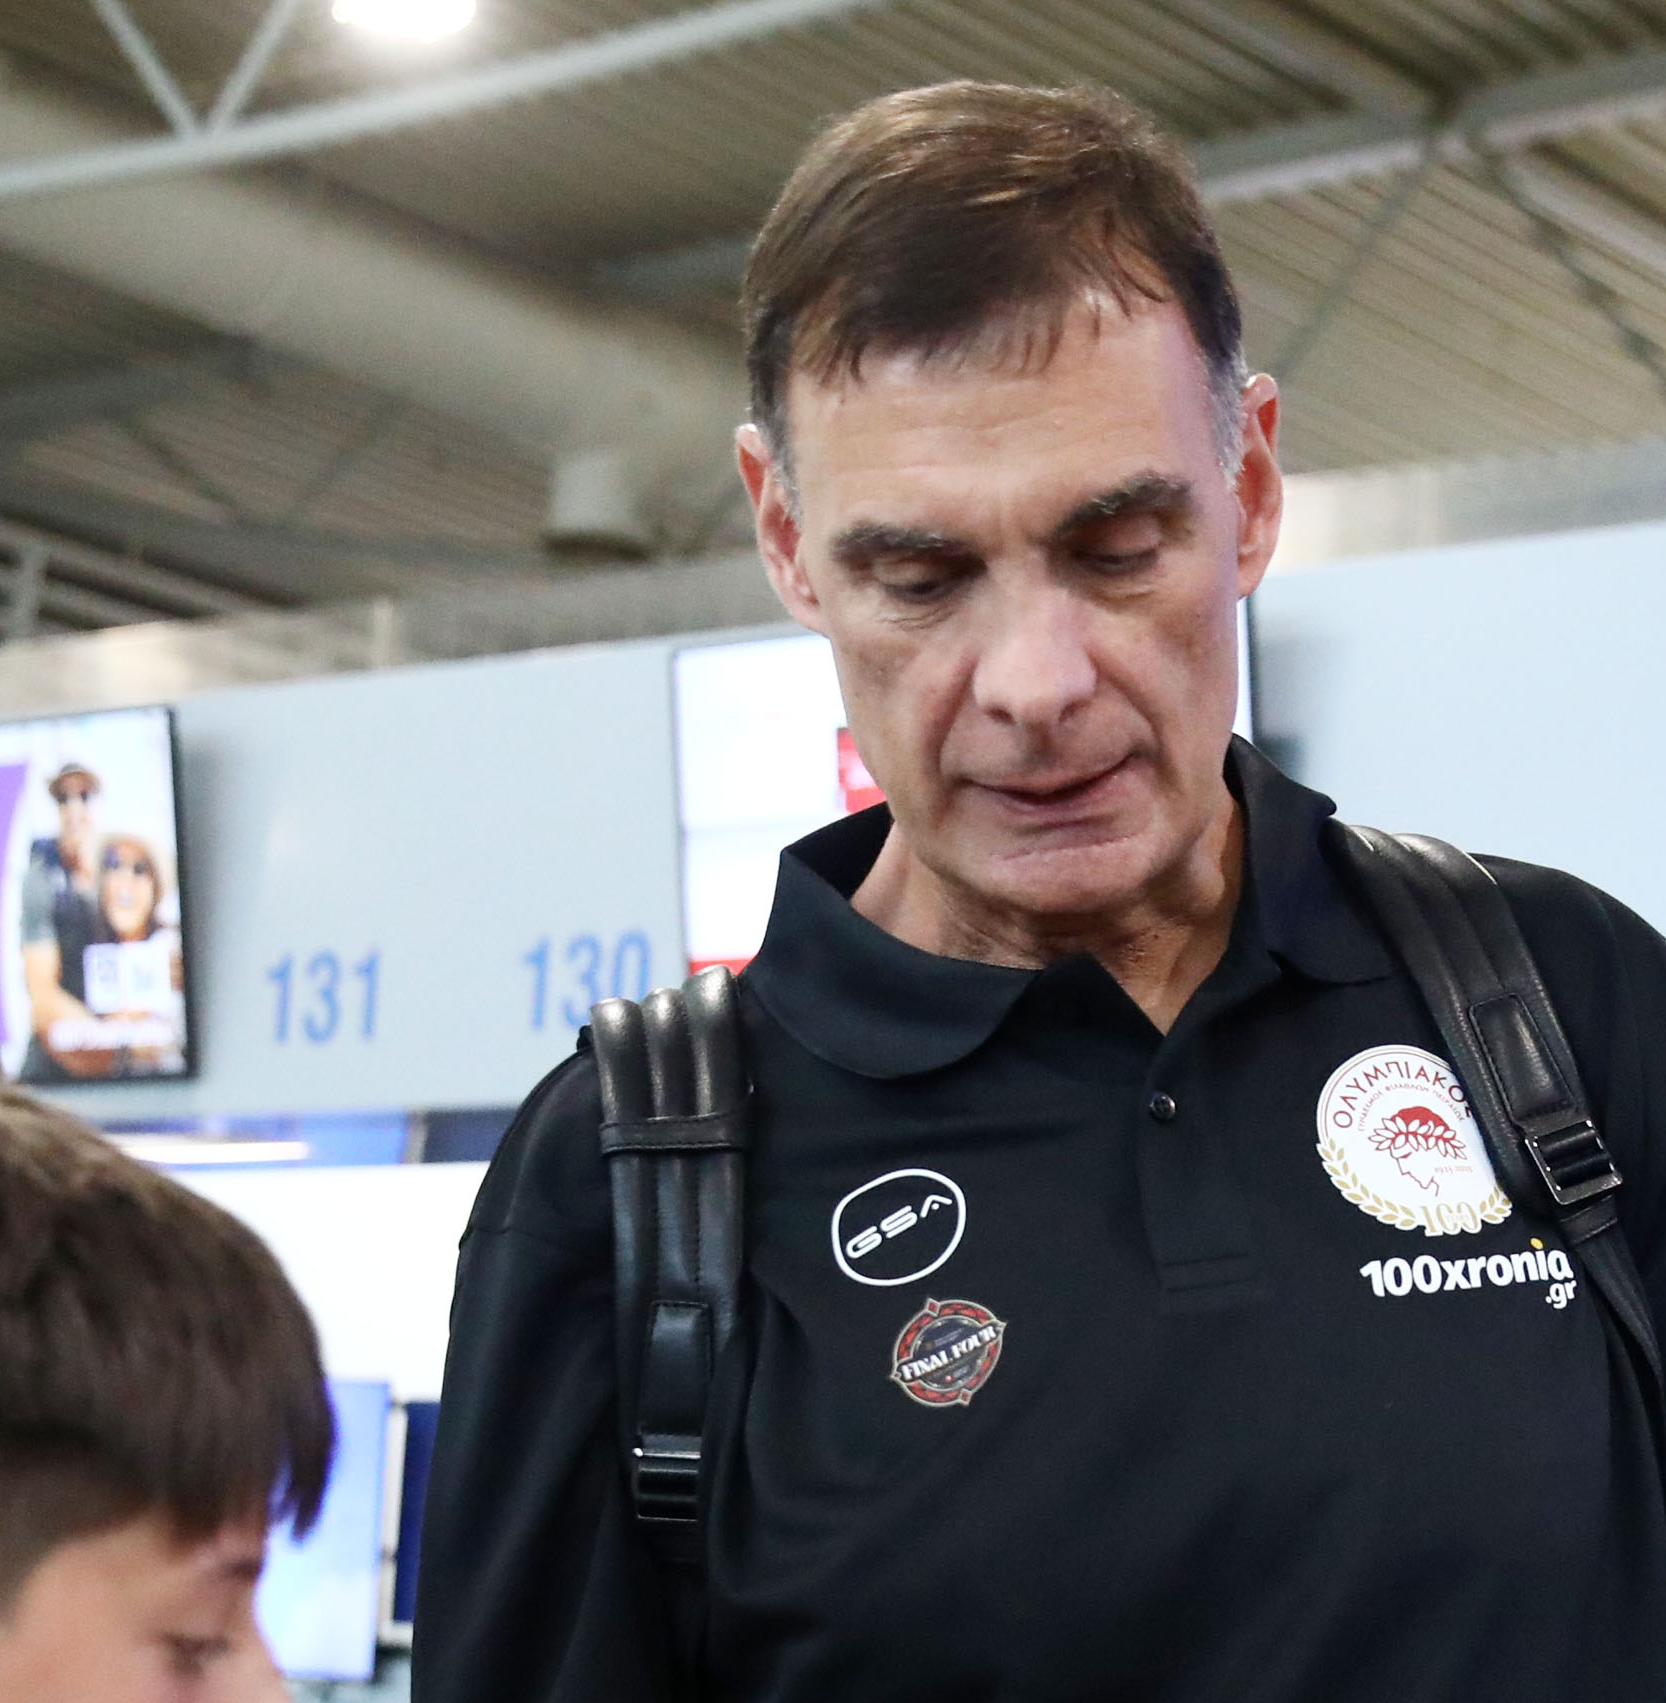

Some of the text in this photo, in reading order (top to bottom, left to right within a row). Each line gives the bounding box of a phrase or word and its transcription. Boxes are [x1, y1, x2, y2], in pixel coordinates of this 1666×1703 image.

[267, 947, 381, 1045] 131
[522, 928, 653, 1031] 130
[846, 1194, 952, 1259] GSA
[1359, 1237, 1574, 1297] 100xronia
[1545, 1280, 1577, 1309] .gr
[901, 1350, 949, 1381] FINAL
[951, 1325, 997, 1358] FOUR
